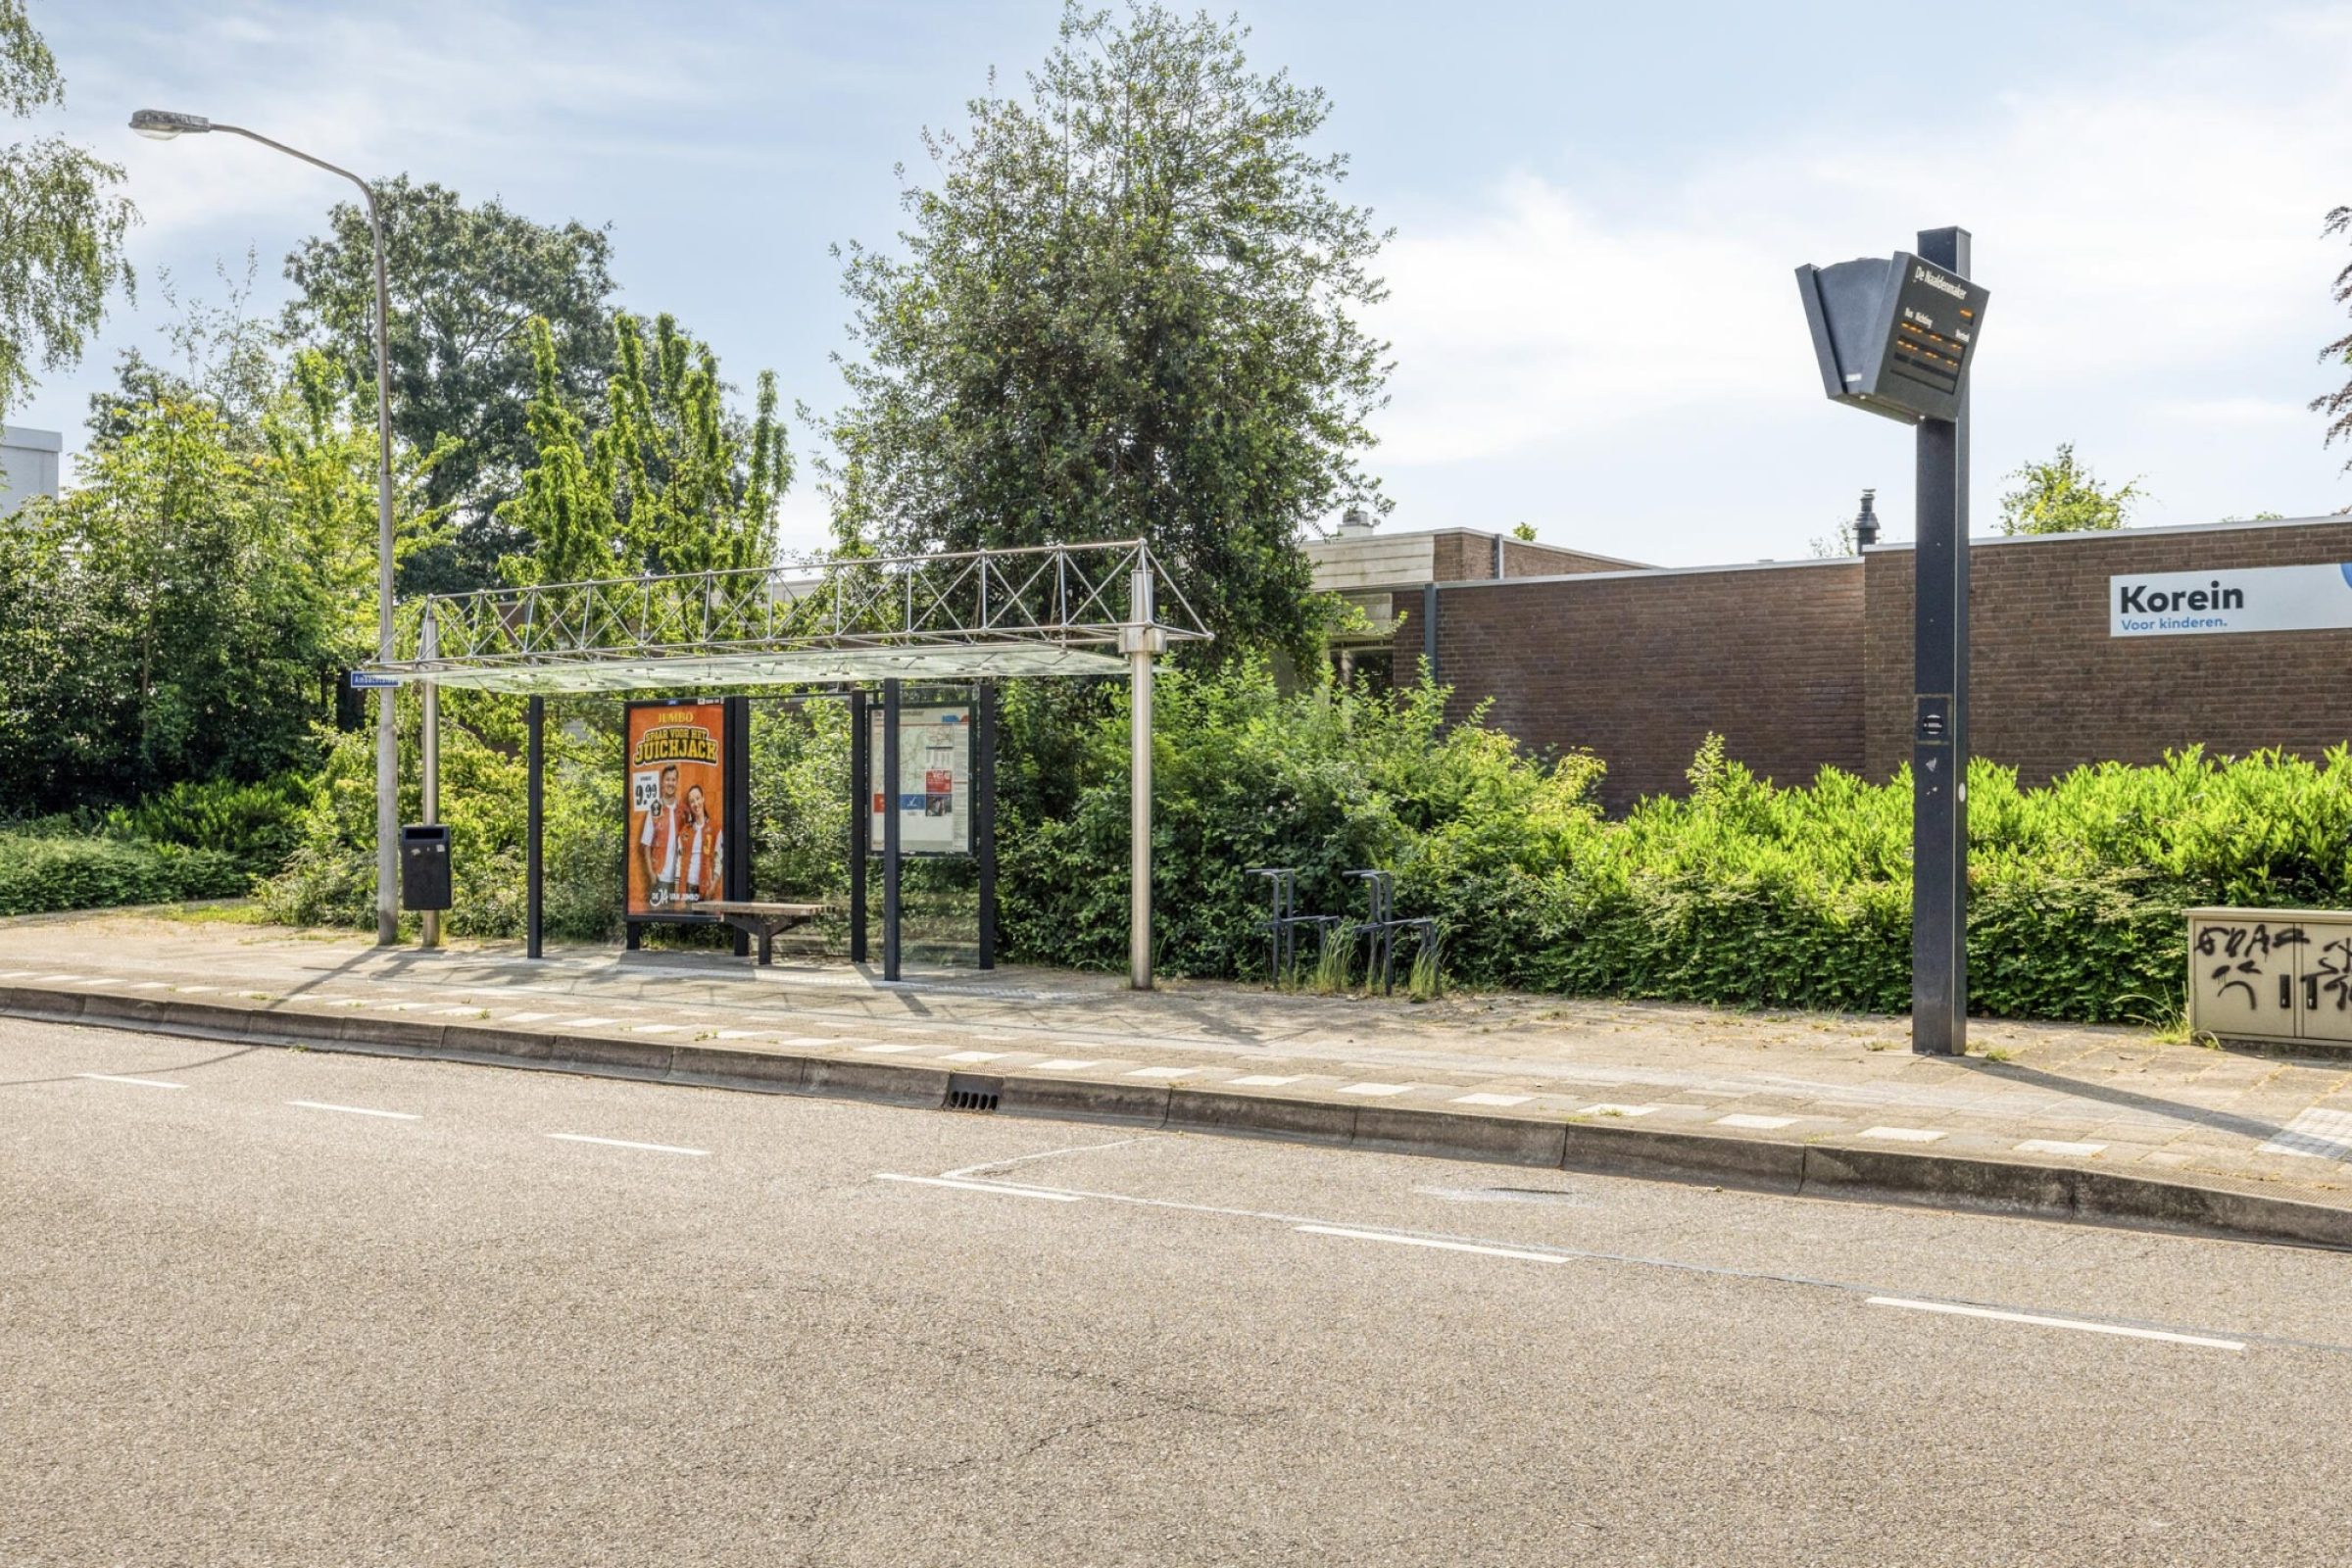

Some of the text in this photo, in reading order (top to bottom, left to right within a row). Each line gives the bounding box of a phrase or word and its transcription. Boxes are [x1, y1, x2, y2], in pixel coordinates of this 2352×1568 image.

[1915, 266, 1925, 280] De
[2120, 579, 2244, 613] Korein
[2121, 616, 2228, 630] Voor kinderen.
[658, 711, 694, 723] JUMBO
[645, 728, 708, 742] SPAAR VOOR HET
[635, 739, 717, 763] JUICHJACK
[635, 783, 658, 806] 9.99
